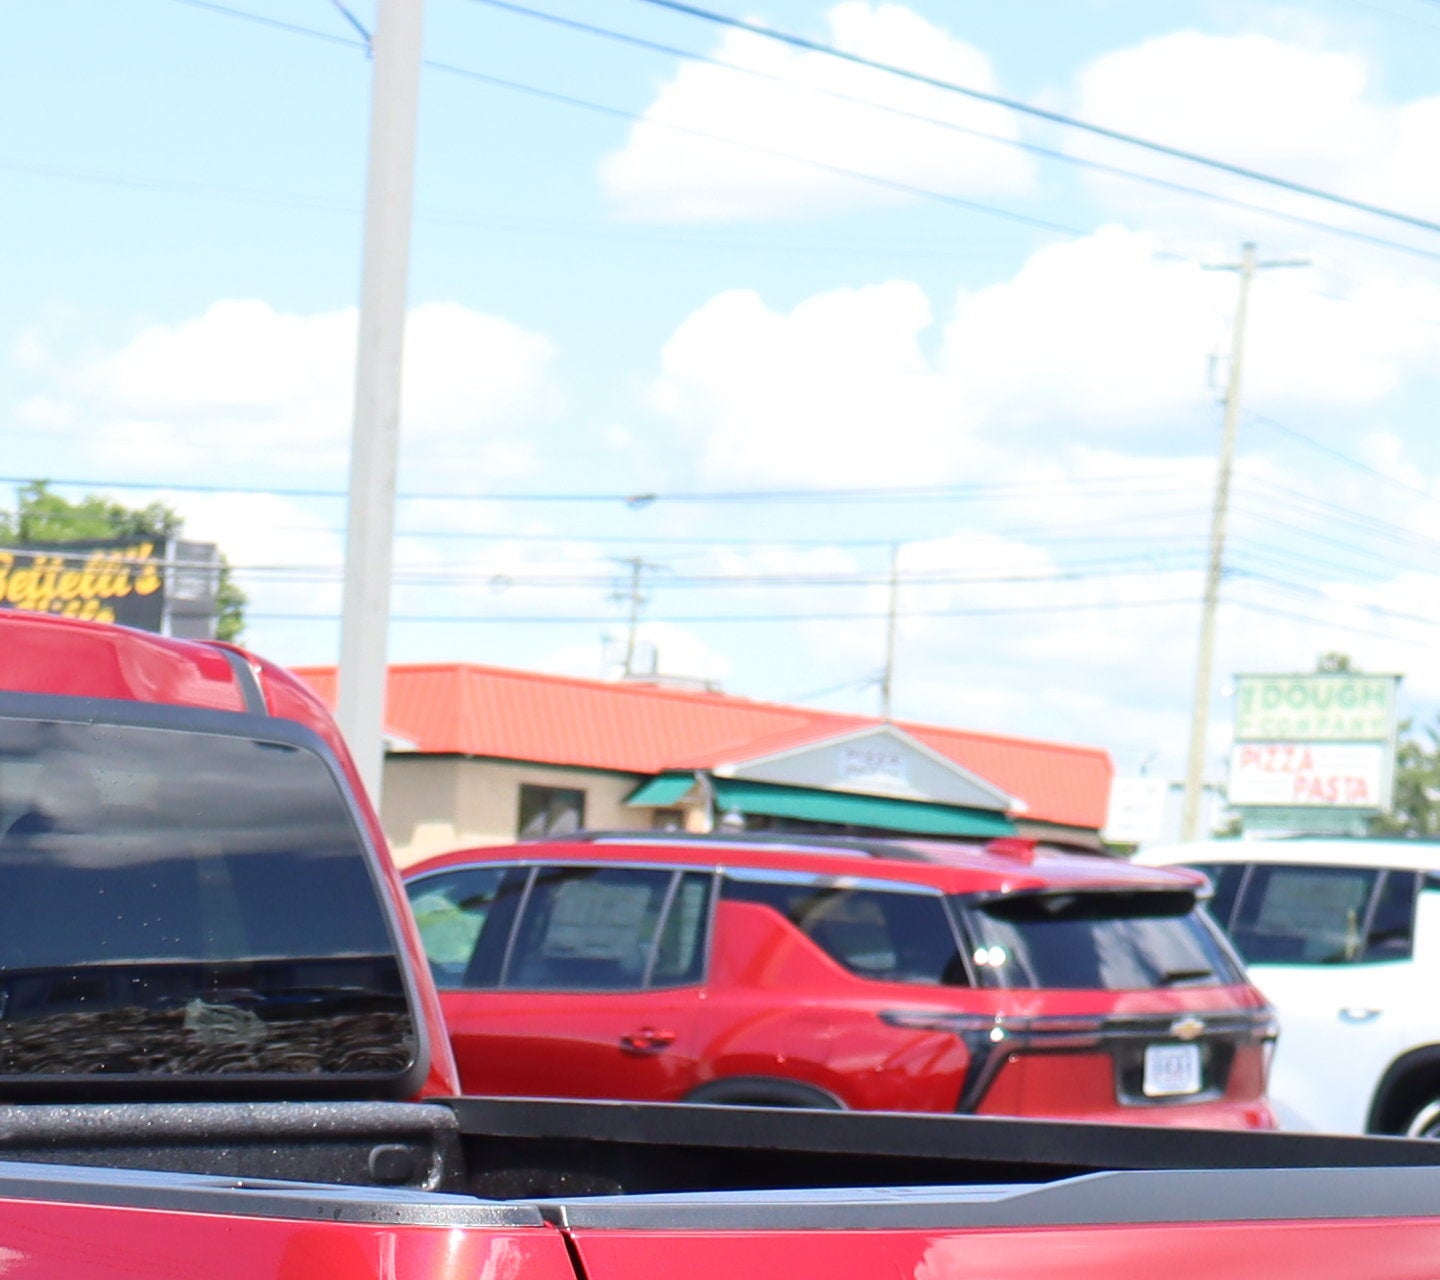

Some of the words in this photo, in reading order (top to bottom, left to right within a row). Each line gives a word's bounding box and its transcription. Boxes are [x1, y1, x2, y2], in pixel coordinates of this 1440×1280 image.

[1262, 684, 1386, 709] DOUGH
[1240, 746, 1314, 773] PIZZA
[1294, 775, 1369, 802] PASTA
